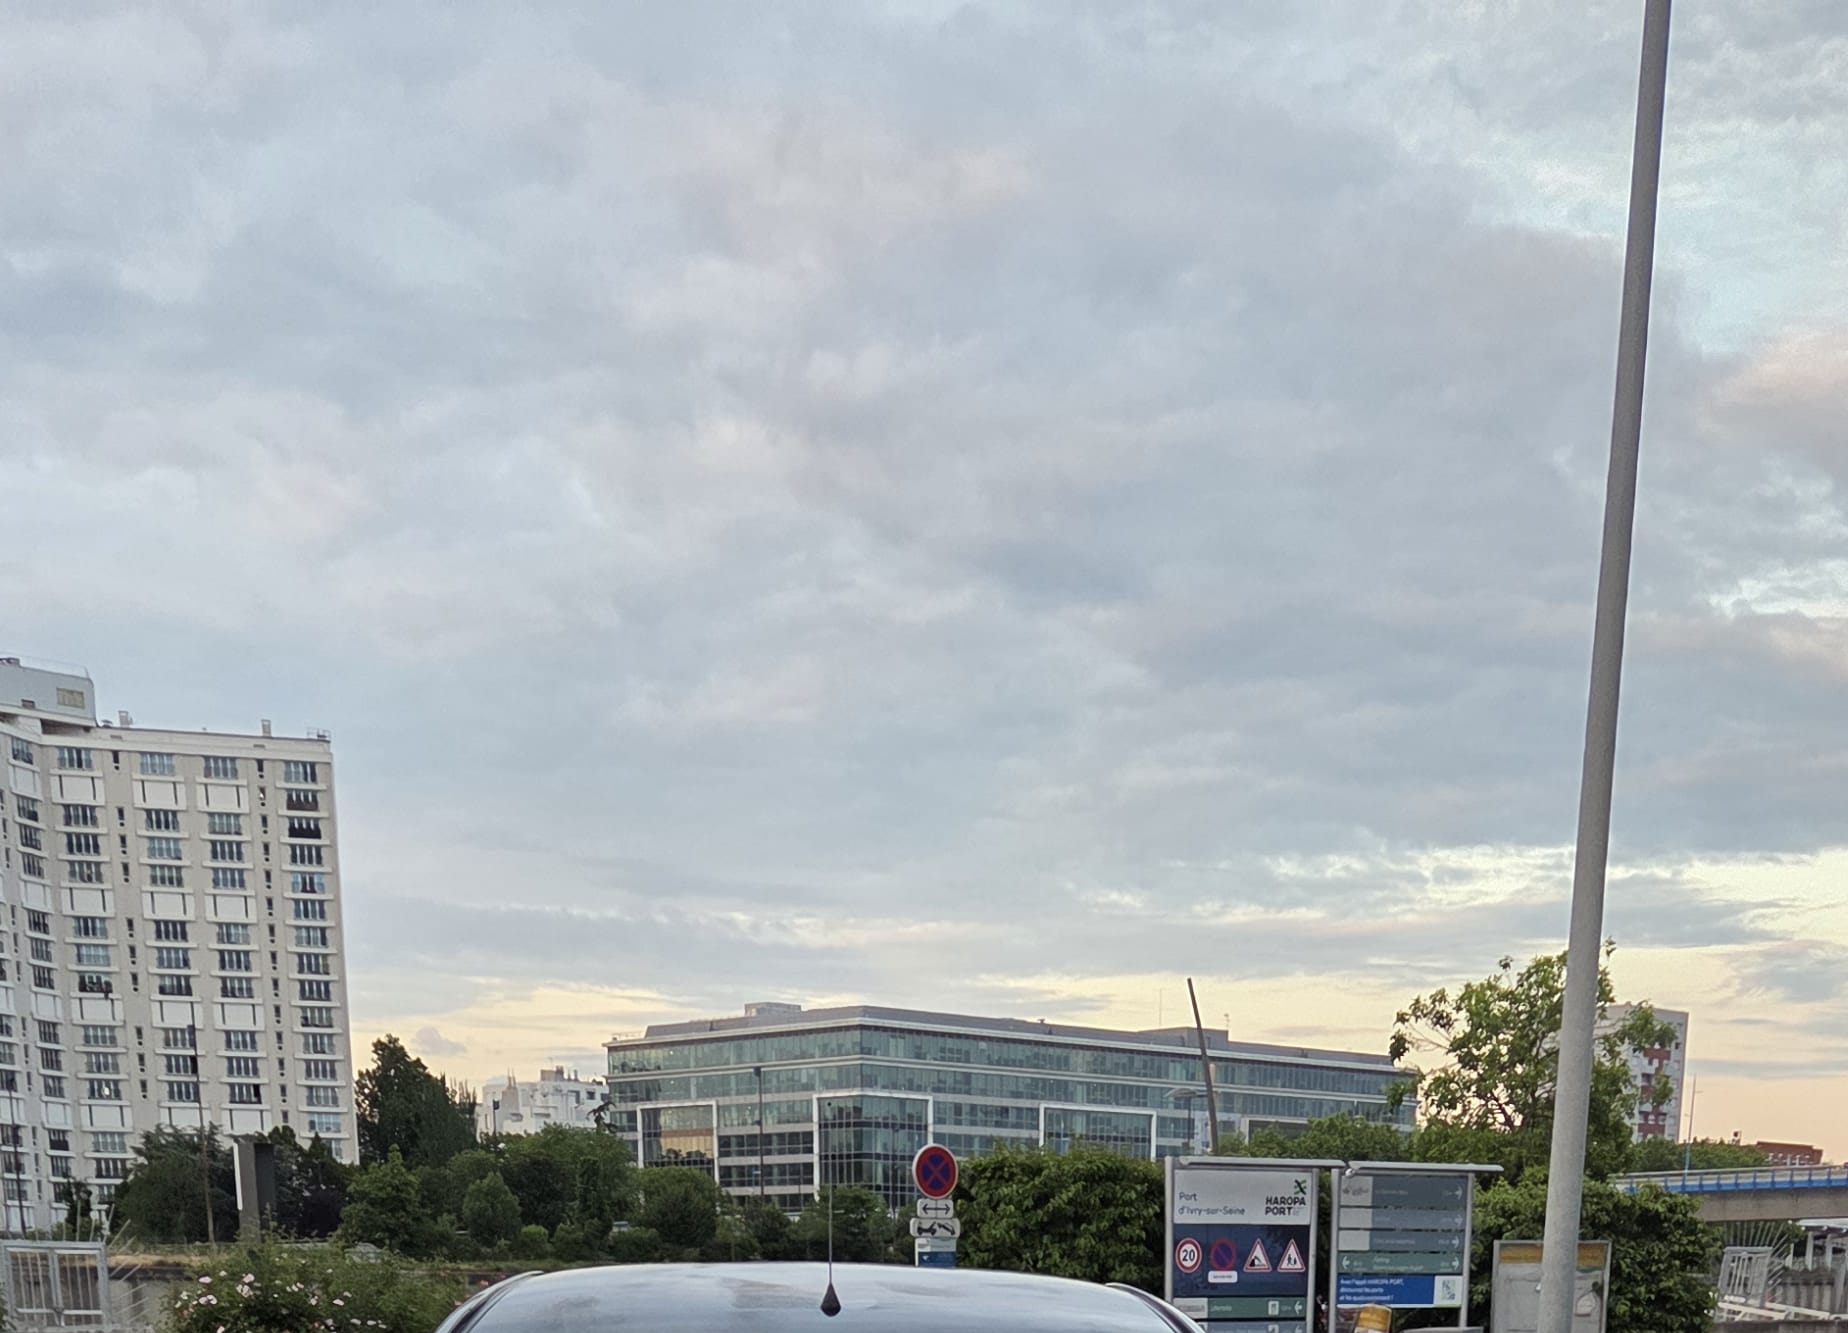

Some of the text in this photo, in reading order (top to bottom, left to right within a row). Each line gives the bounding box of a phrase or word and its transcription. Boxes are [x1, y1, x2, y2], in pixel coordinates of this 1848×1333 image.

[1179, 1192, 1198, 1201] Port
[1265, 1195, 1306, 1206] HAROPA
[1265, 1206, 1293, 1216] PORT
[1182, 1249, 1196, 1262] 20
